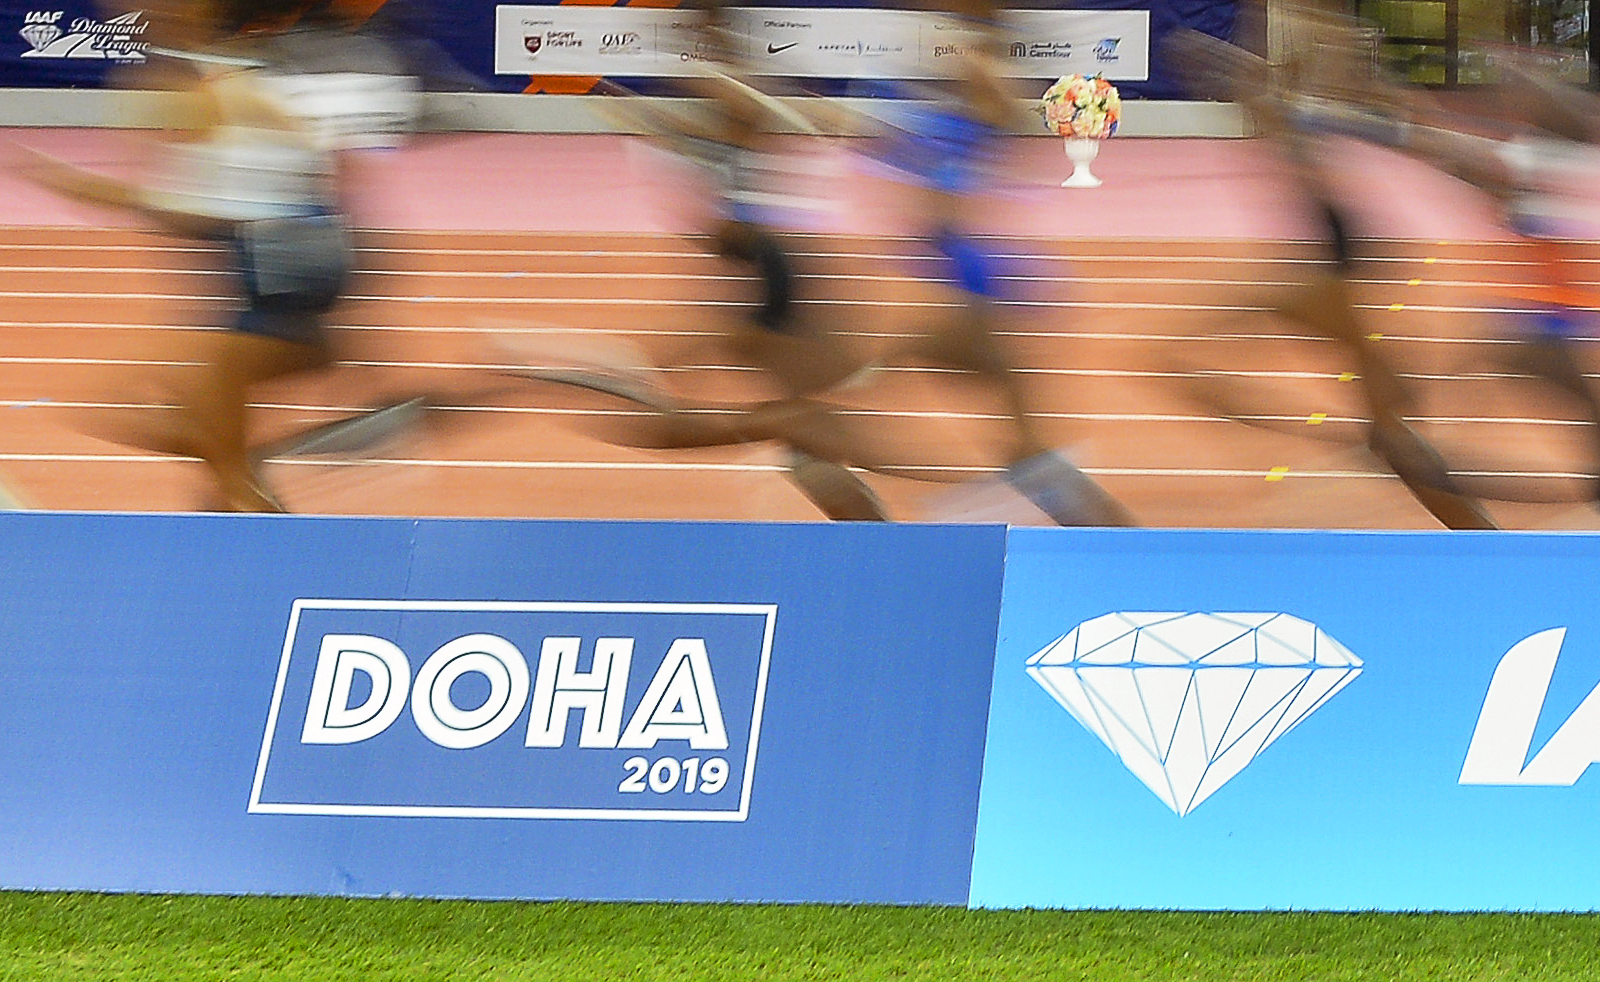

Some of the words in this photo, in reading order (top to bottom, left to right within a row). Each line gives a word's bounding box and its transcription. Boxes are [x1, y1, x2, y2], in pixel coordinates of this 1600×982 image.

[24, 10, 64, 24] IAAF
[68, 17, 149, 35] Diamond
[300, 633, 729, 750] DOHA
[618, 757, 730, 794] 2019
